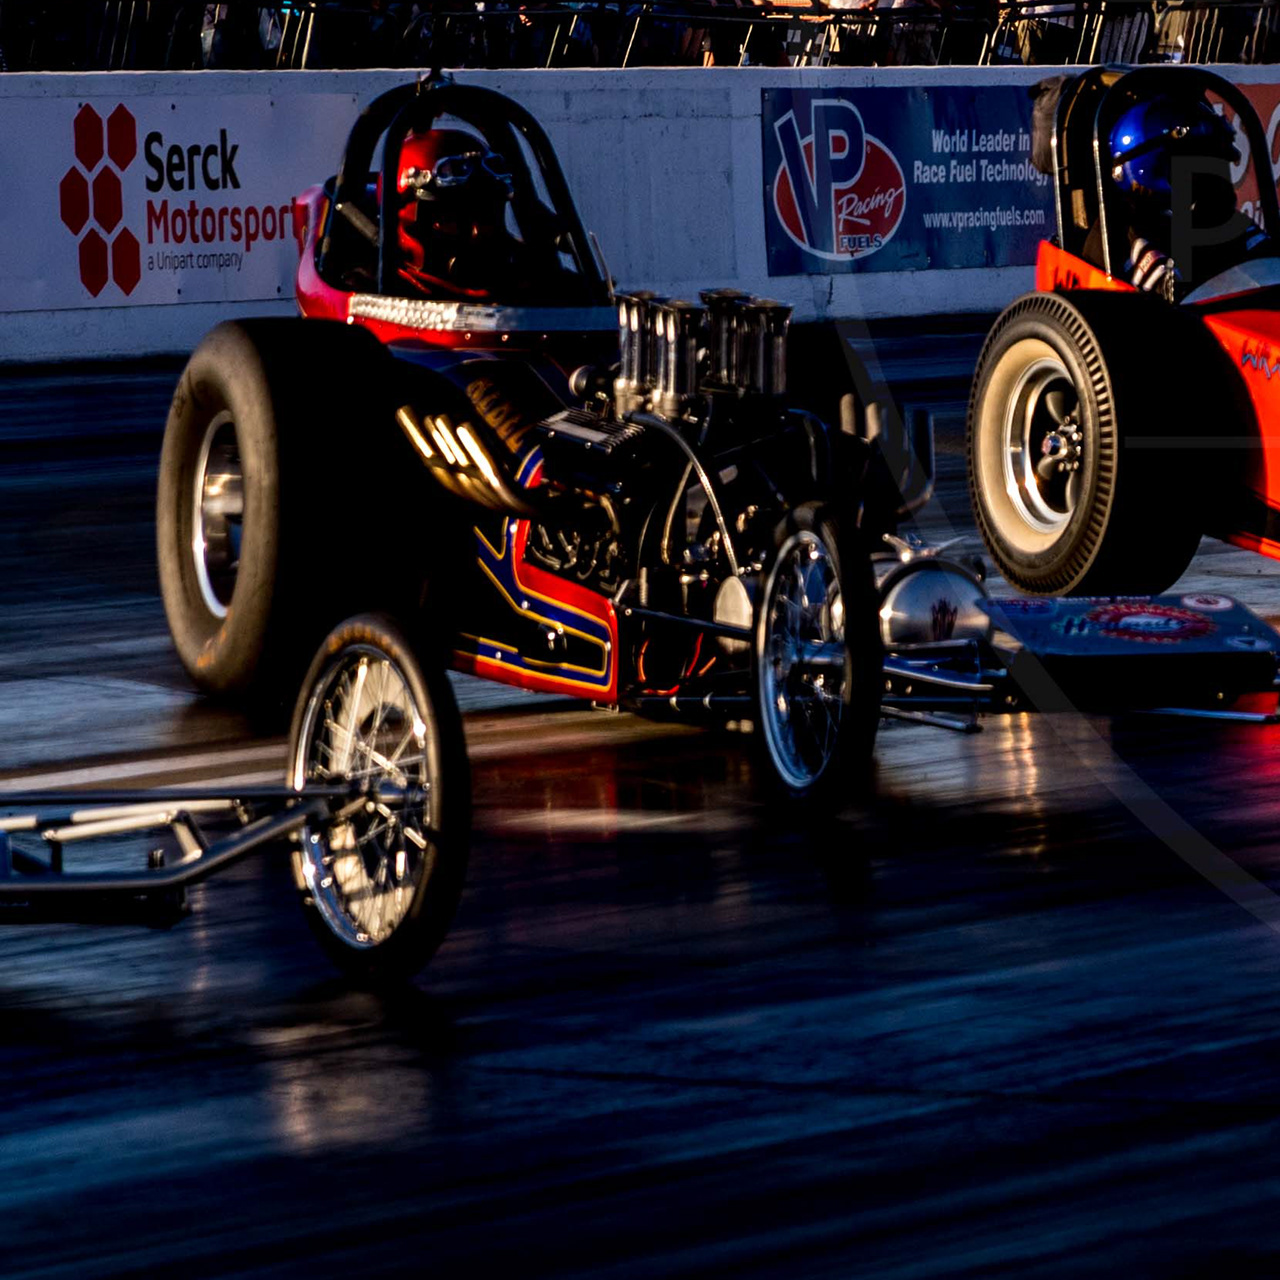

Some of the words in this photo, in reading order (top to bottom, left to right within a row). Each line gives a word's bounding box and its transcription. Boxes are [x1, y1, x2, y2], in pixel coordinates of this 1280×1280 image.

[931, 130, 969, 154] World
[971, 129, 1015, 153] Leader
[1018, 129, 1030, 151] in
[144, 128, 241, 193] Serck
[914, 160, 946, 184] Race
[949, 159, 976, 183] Fuel
[773, 99, 867, 256] VP
[837, 186, 907, 231] Racing
[923, 206, 1046, 234] www.vpracingfuels.com
[839, 233, 884, 250] FUELS
[148, 256, 155, 271] a
[157, 251, 194, 274] Unipart
[196, 251, 244, 273] company
